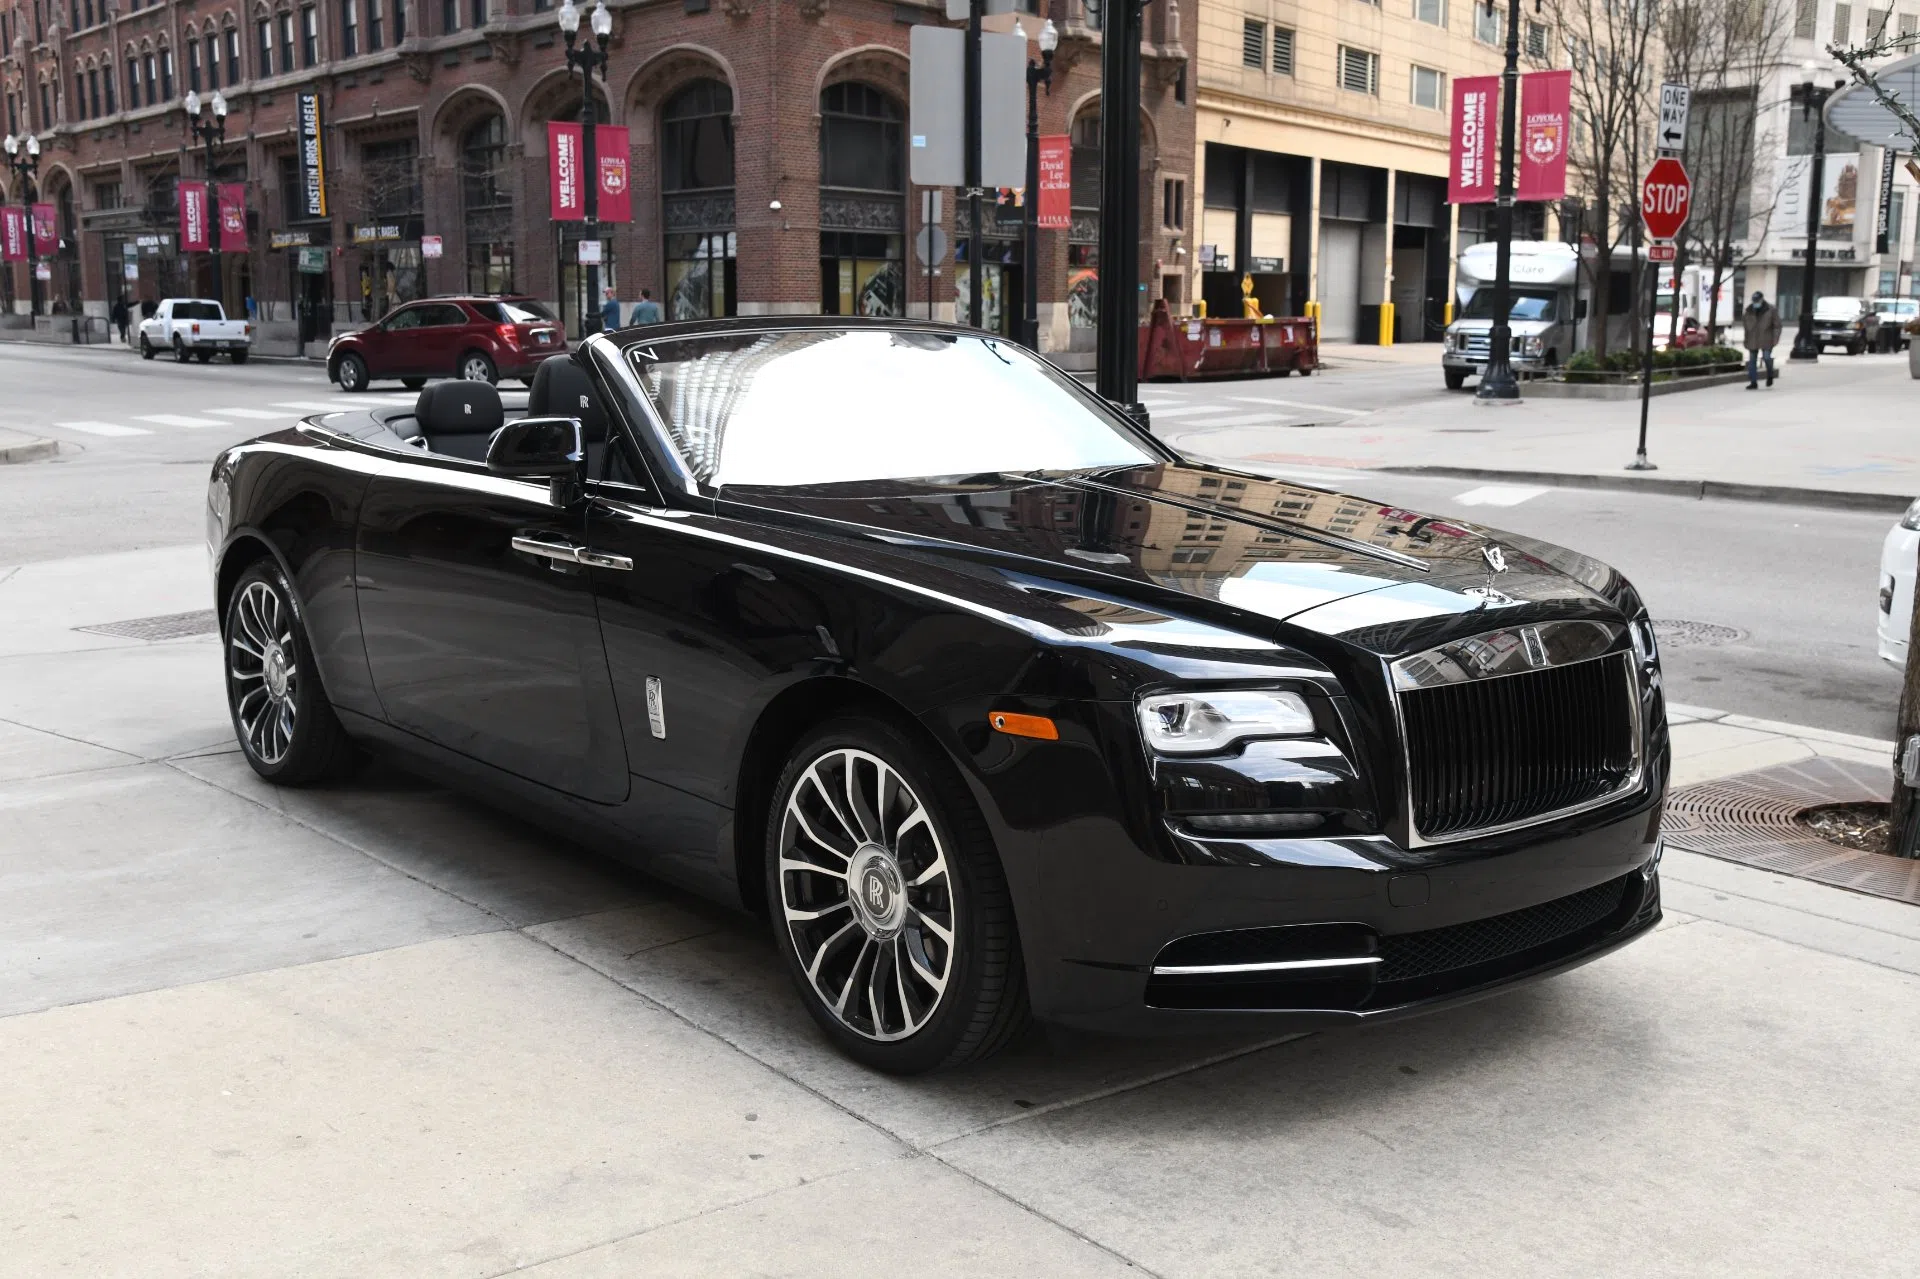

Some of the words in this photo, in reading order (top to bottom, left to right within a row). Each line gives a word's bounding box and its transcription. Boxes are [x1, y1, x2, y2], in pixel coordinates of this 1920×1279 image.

[303, 95, 316, 135] BAGELS
[1478, 92, 1486, 127] CAMPUS
[1662, 108, 1685, 124] WAY
[1664, 89, 1686, 107] ONE
[1527, 113, 1562, 123] LOYOLA
[1461, 92, 1478, 188] WELCOME
[557, 134, 570, 208] WELCOME
[601, 157, 625, 165] LOYOLA
[1881, 149, 1893, 206] ORDSTROM
[307, 168, 321, 214] EINSTEIN
[1644, 183, 1688, 214] STOP
[7, 213, 17, 255] WELCOME
[185, 191, 196, 242] WELCOME
[1651, 248, 1661, 258] ALL
[1662, 248, 1674, 258] WAY
